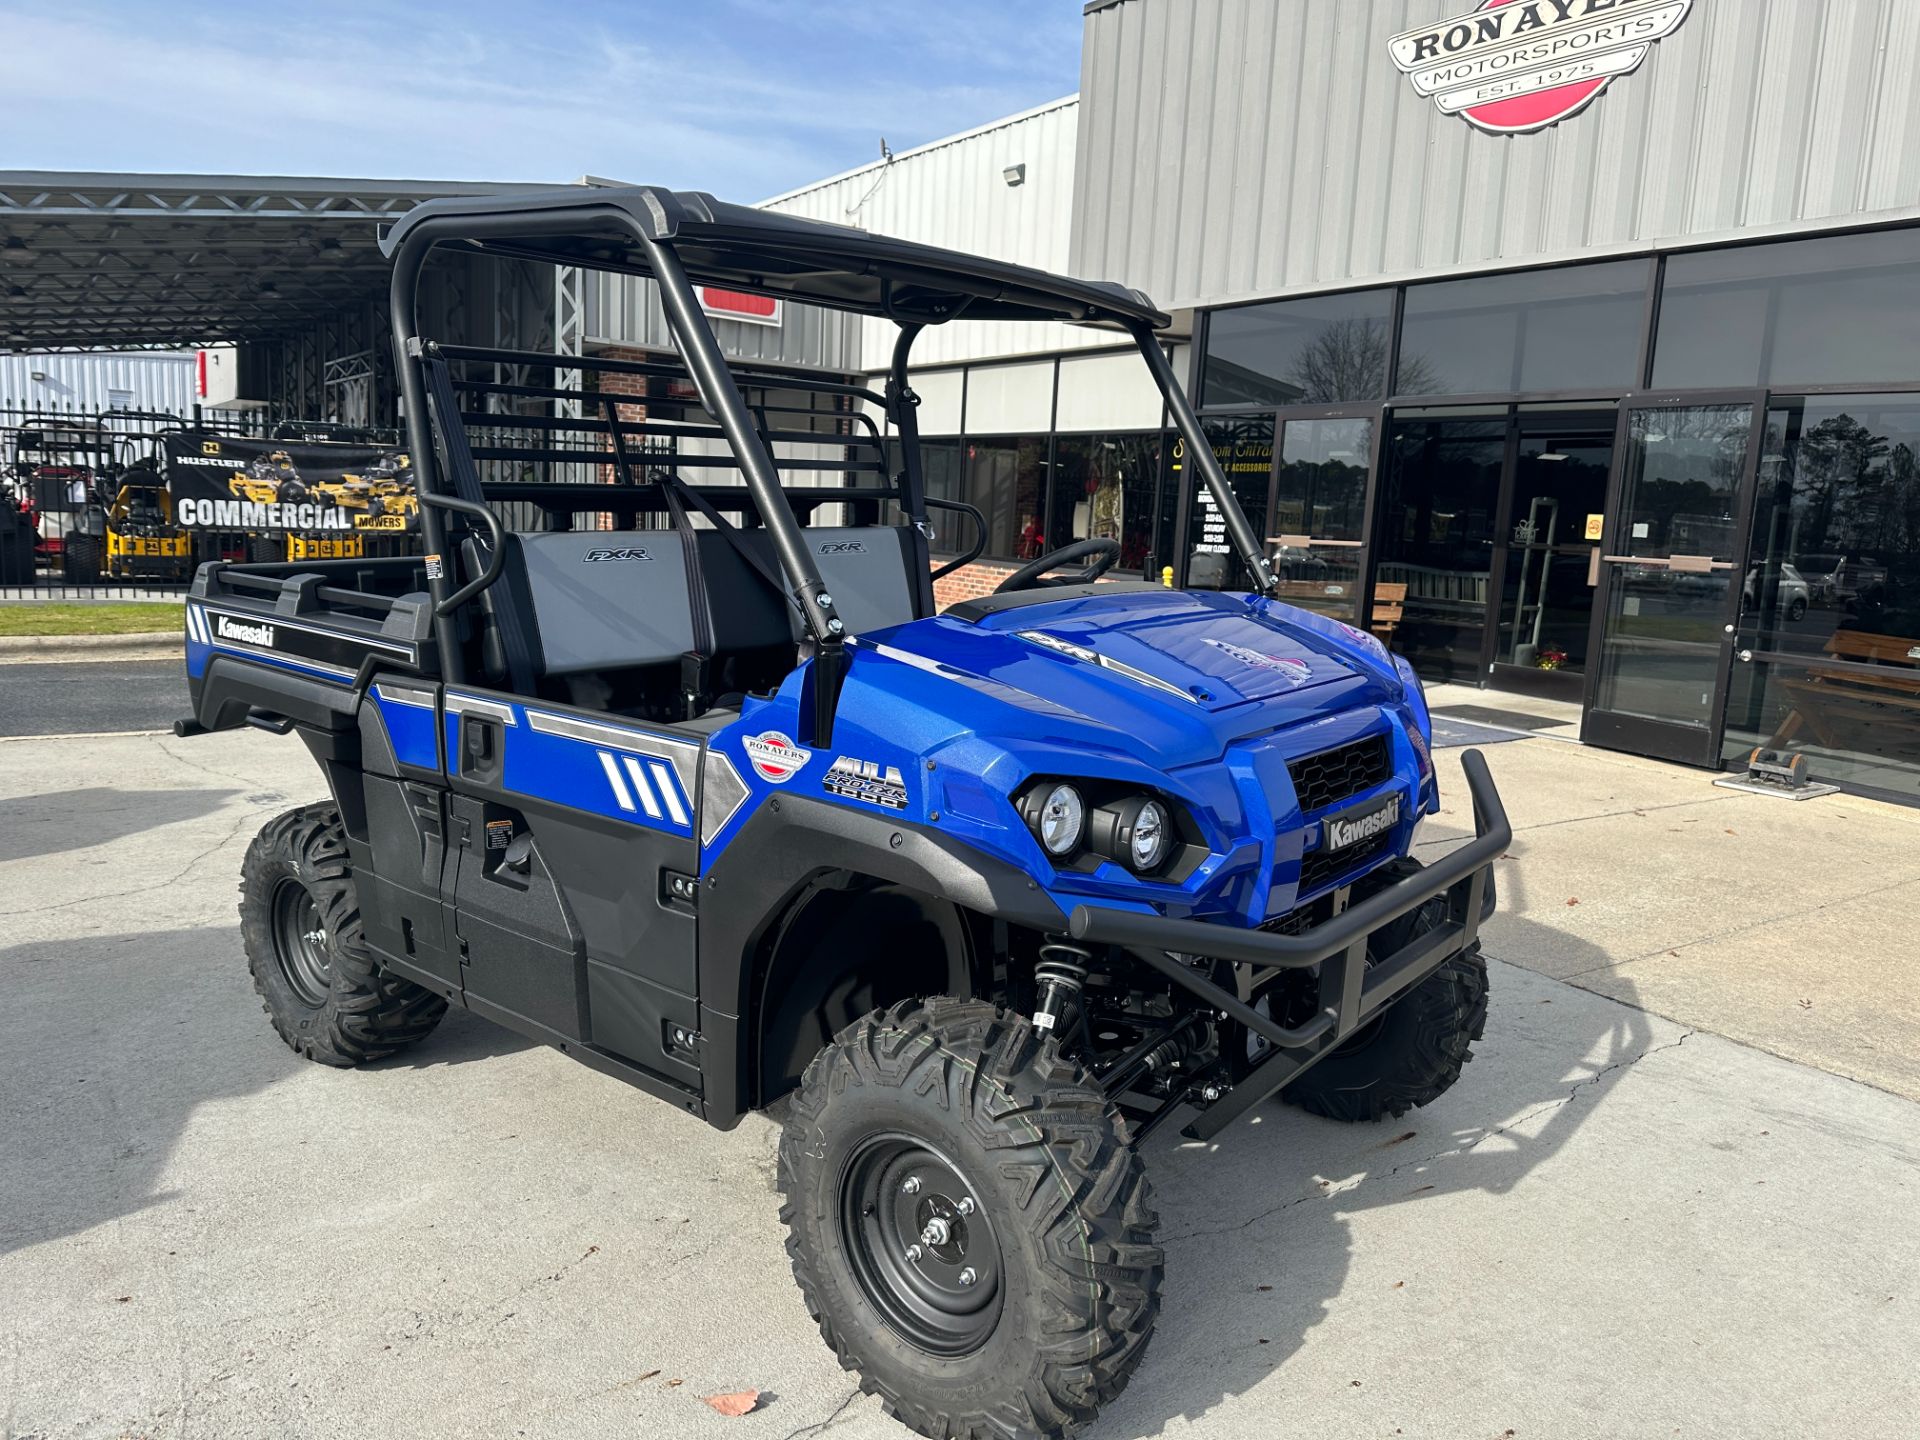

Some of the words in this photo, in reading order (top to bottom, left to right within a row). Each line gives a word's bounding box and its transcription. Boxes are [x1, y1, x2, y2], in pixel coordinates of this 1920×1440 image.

[1410, 12, 1507, 63] RON
[1433, 16, 1655, 85] MOTORSPORTS
[1477, 81, 1521, 99] EST.
[1535, 63, 1595, 86] 1975
[176, 456, 246, 468] HUSTLER
[1231, 463, 1273, 472] ACCESSORIES
[178, 498, 352, 530] COMMERCIAL
[358, 517, 401, 528] MOWERS
[583, 547, 654, 562] FXR
[818, 541, 867, 555] FXR
[218, 616, 275, 647] Kawasaki
[749, 741, 770, 751] RON
[771, 746, 804, 761] AYERS
[1330, 793, 1404, 850] Kawasaki
